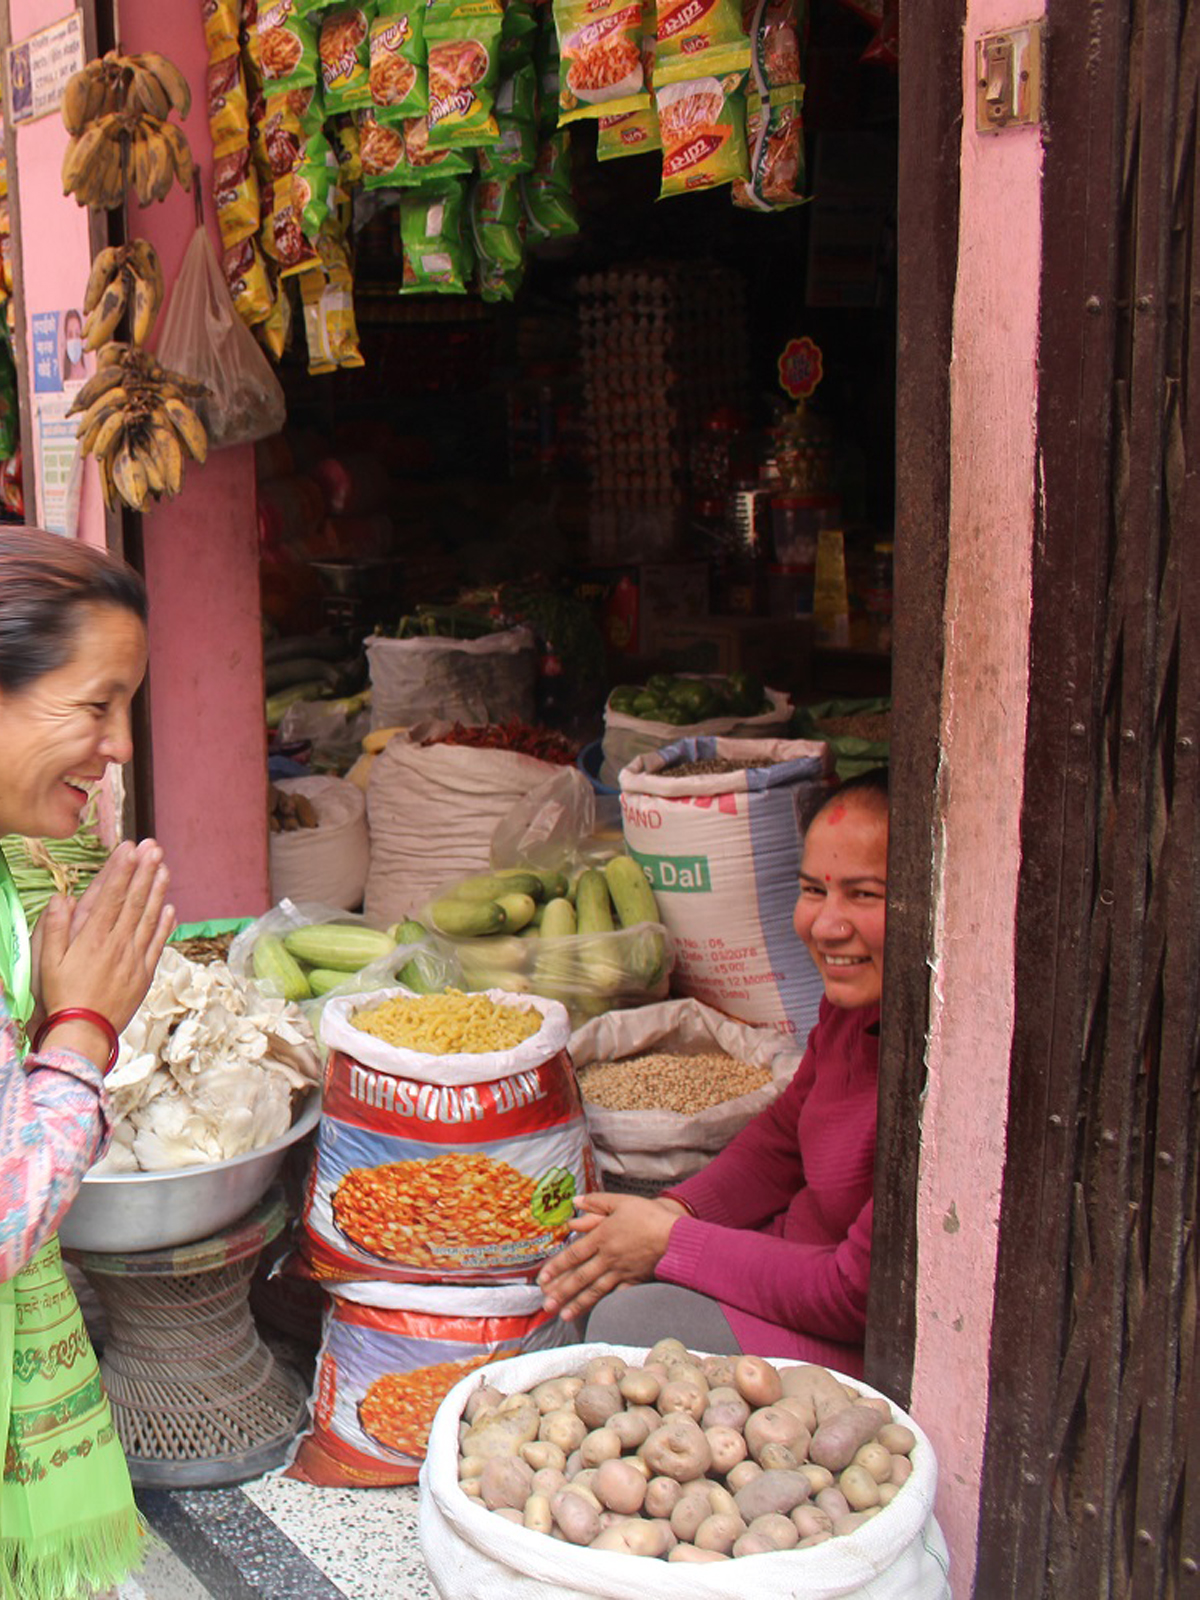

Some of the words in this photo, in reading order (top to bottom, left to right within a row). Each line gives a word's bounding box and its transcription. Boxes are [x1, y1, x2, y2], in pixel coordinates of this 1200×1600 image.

[659, 861, 703, 888] Dal
[350, 1064, 484, 1124] MASOUR
[490, 1068, 547, 1114] DAL
